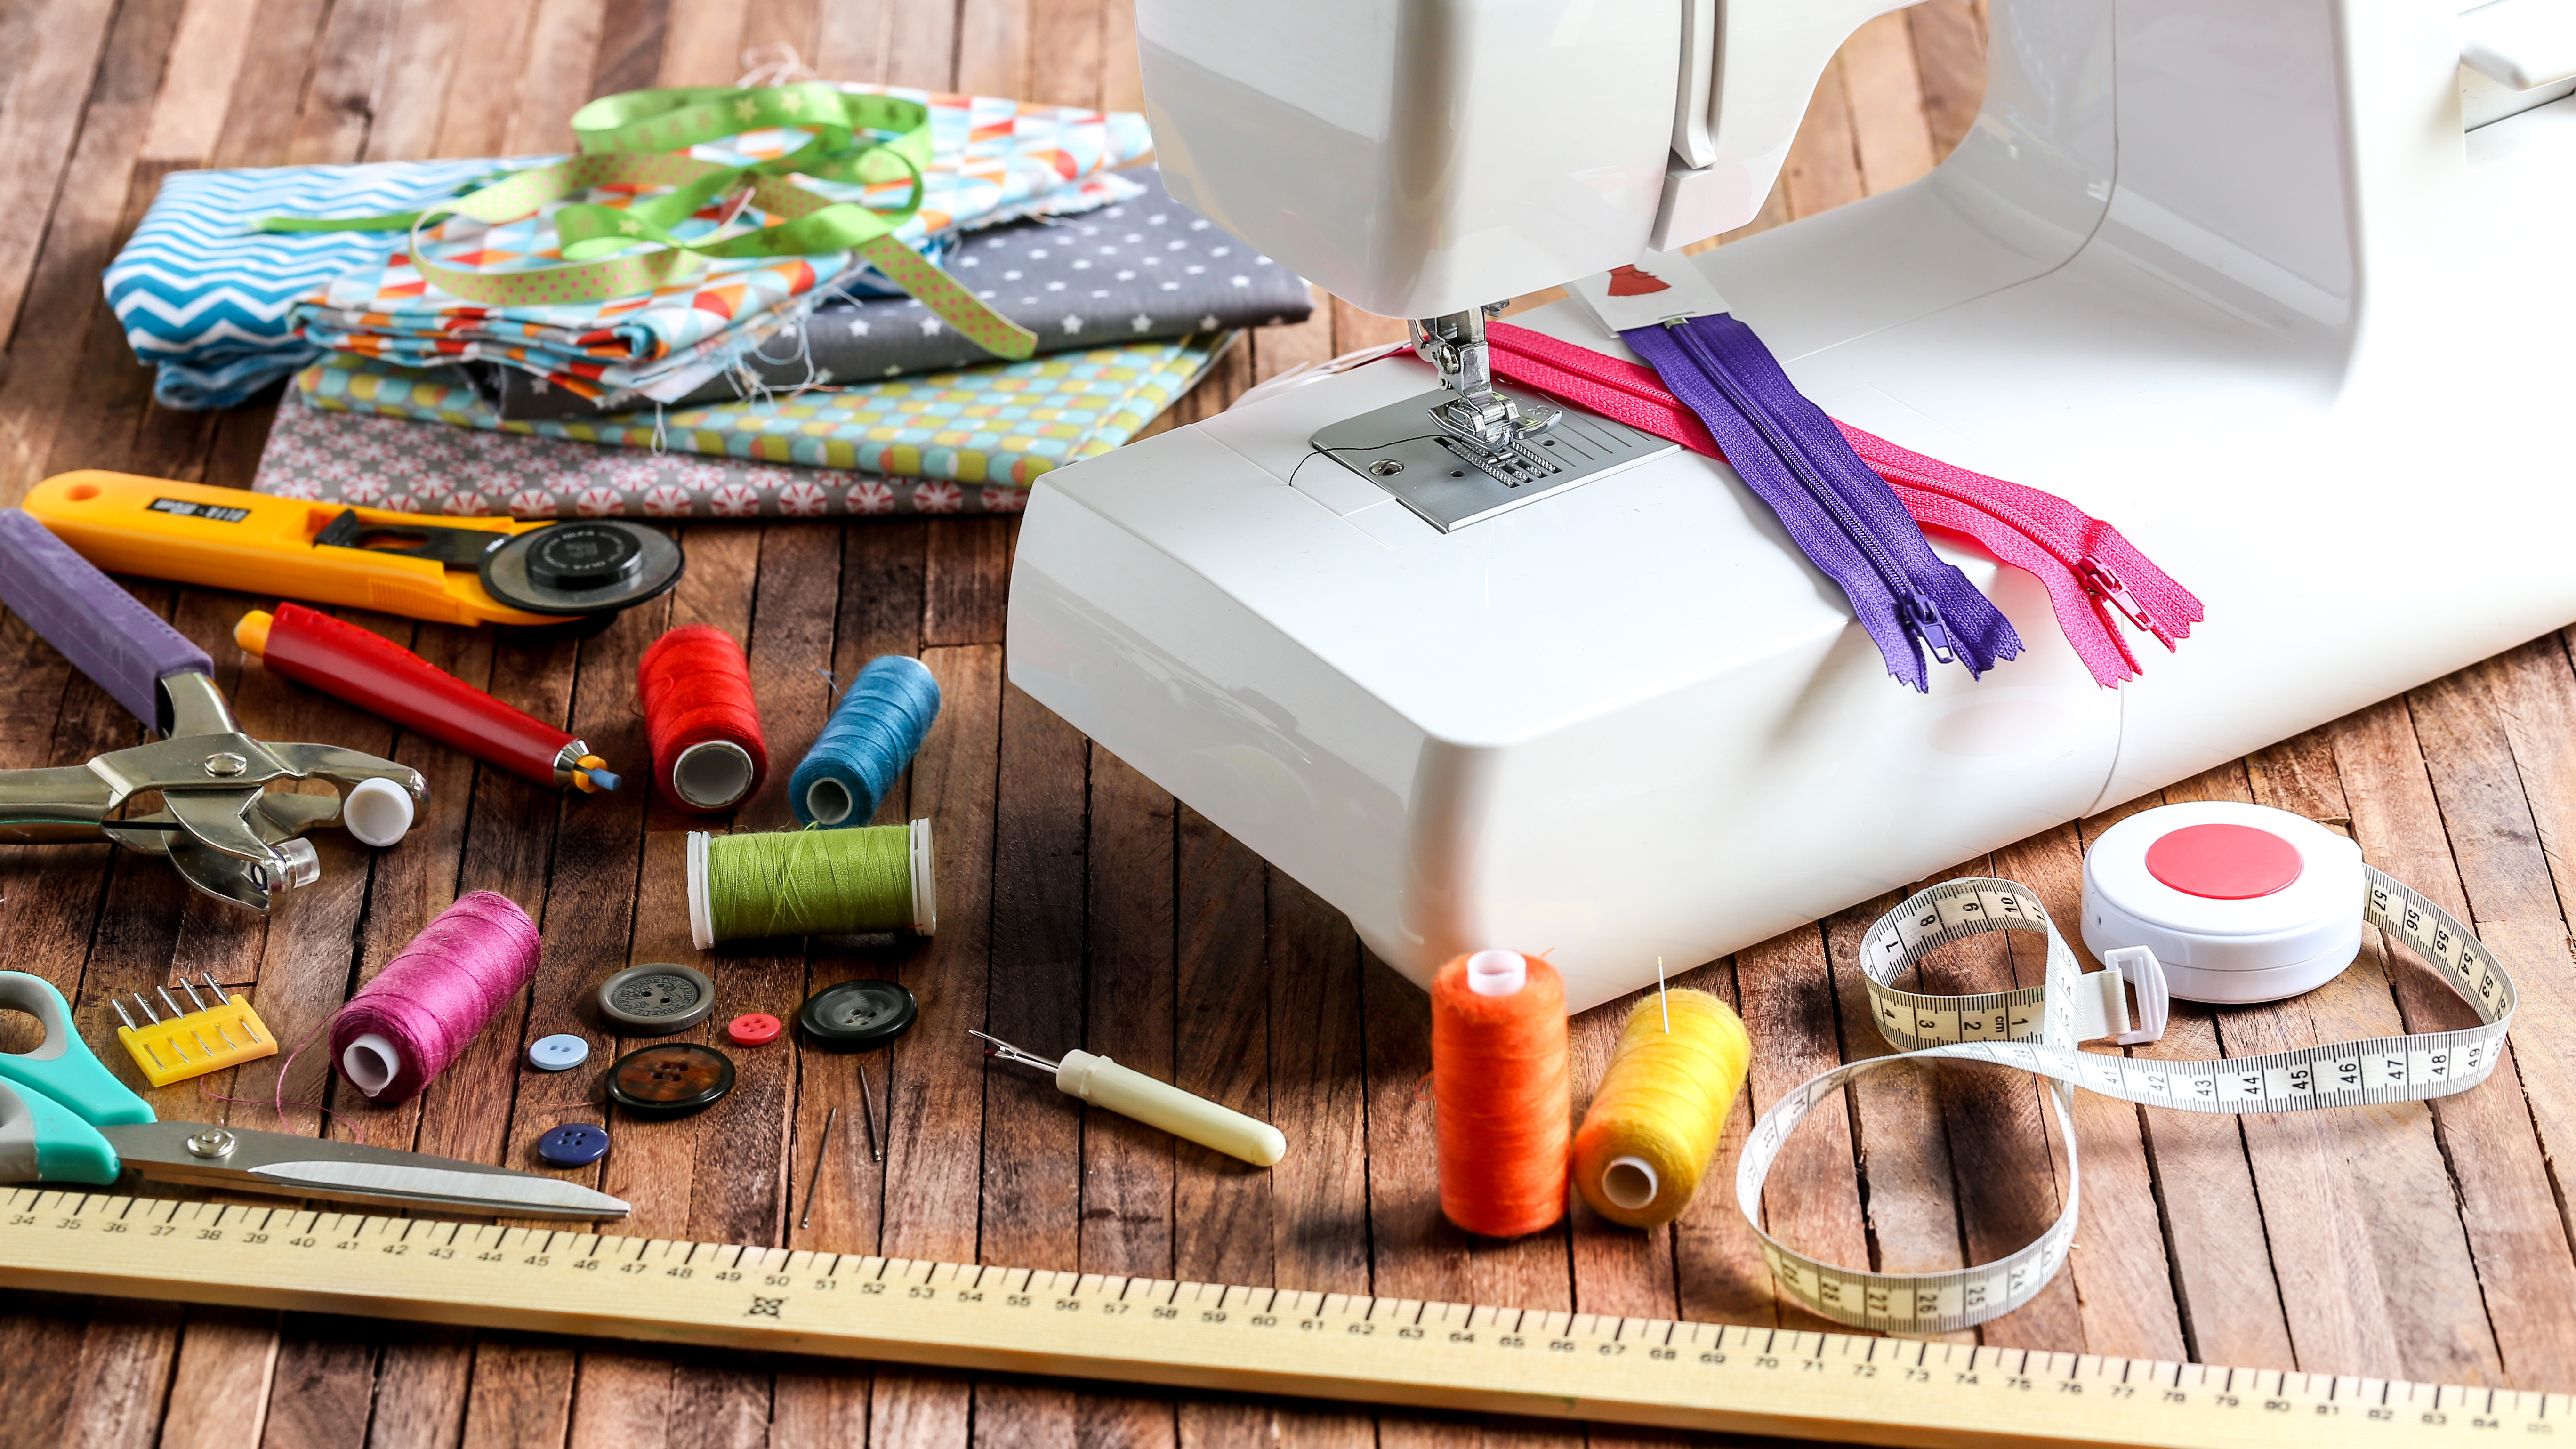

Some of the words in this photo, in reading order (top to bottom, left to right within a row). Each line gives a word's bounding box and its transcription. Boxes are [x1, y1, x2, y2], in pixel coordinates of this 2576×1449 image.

[1885, 940, 1899, 953] 7
[1919, 914, 1936, 927] 8
[1962, 902, 1979, 912] 9
[2001, 897, 2018, 913] 10
[2373, 889, 2387, 911] 57
[2407, 909, 2419, 932] 56
[2436, 930, 2448, 953] 55
[2461, 952, 2473, 976] 54
[2482, 975, 2494, 998] 53
[627, 978, 660, 990] TERRE
[2061, 977, 2071, 996] 14
[1884, 1009, 1896, 1019] 4
[2011, 1018, 2028, 1026] 1
[2060, 1007, 2069, 1027] 15
[1919, 1019, 1935, 1029] 3
[1964, 1021, 1982, 1031] 2
[1995, 1016, 2004, 1033] cm
[2104, 1071, 2119, 1084] 41
[2148, 1076, 2165, 1091] 42
[2194, 1079, 2212, 1096] 43
[2244, 1076, 2260, 1095] 44
[2291, 1070, 2308, 1090] 45
[2340, 1063, 2357, 1084] 46
[2387, 1060, 2404, 1080] 47
[2431, 1054, 2447, 1075] 48
[2468, 1048, 2480, 1067] 49
[1918, 1294, 1937, 1313] 26
[1968, 1286, 1985, 1305] 25
[9, 1215, 36, 1225] 34
[56, 1218, 82, 1230] 35
[103, 1222, 127, 1233] 36
[149, 1225, 176, 1237] 37
[196, 1229, 223, 1240] 38
[242, 1232, 269, 1244] 39
[290, 1237, 316, 1248] 40
[336, 1241, 359, 1250] 41
[382, 1245, 409, 1255] 42
[428, 1248, 455, 1259] 43
[477, 1252, 503, 1262] 44
[524, 1256, 549, 1266] 45
[573, 1259, 599, 1270] 46
[620, 1263, 647, 1273] 47
[667, 1267, 693, 1279] 48
[715, 1272, 742, 1282] 49
[765, 1275, 790, 1287] 50
[815, 1279, 837, 1290] 51
[862, 1282, 886, 1295] 52
[909, 1286, 935, 1299] 53
[959, 1291, 983, 1302] 54
[1007, 1295, 1031, 1307] 55
[1056, 1299, 1080, 1311] 56
[1103, 1303, 1129, 1314] 57
[1153, 1306, 1178, 1319] 58
[1202, 1312, 1227, 1323] 59
[1251, 1315, 1278, 1327] 60
[1300, 1319, 1324, 1330] 61
[1347, 1323, 1375, 1336] 62
[1398, 1328, 1425, 1338] 63
[1449, 1332, 1474, 1343] 64
[1499, 1336, 1525, 1347] 65
[1549, 1340, 1575, 1352] 66
[1598, 1344, 1626, 1354] 67
[1649, 1347, 1677, 1360] 68
[1699, 1352, 1726, 1364] 69
[1755, 1356, 1779, 1368] 70
[1804, 1360, 1824, 1371] 71
[1854, 1364, 1877, 1378] 72
[1906, 1368, 1930, 1382] 73
[1957, 1373, 1978, 1385] 74
[2008, 1377, 2031, 1390] 75
[2060, 1382, 2083, 1394] 76
[2112, 1386, 2134, 1398] 77
